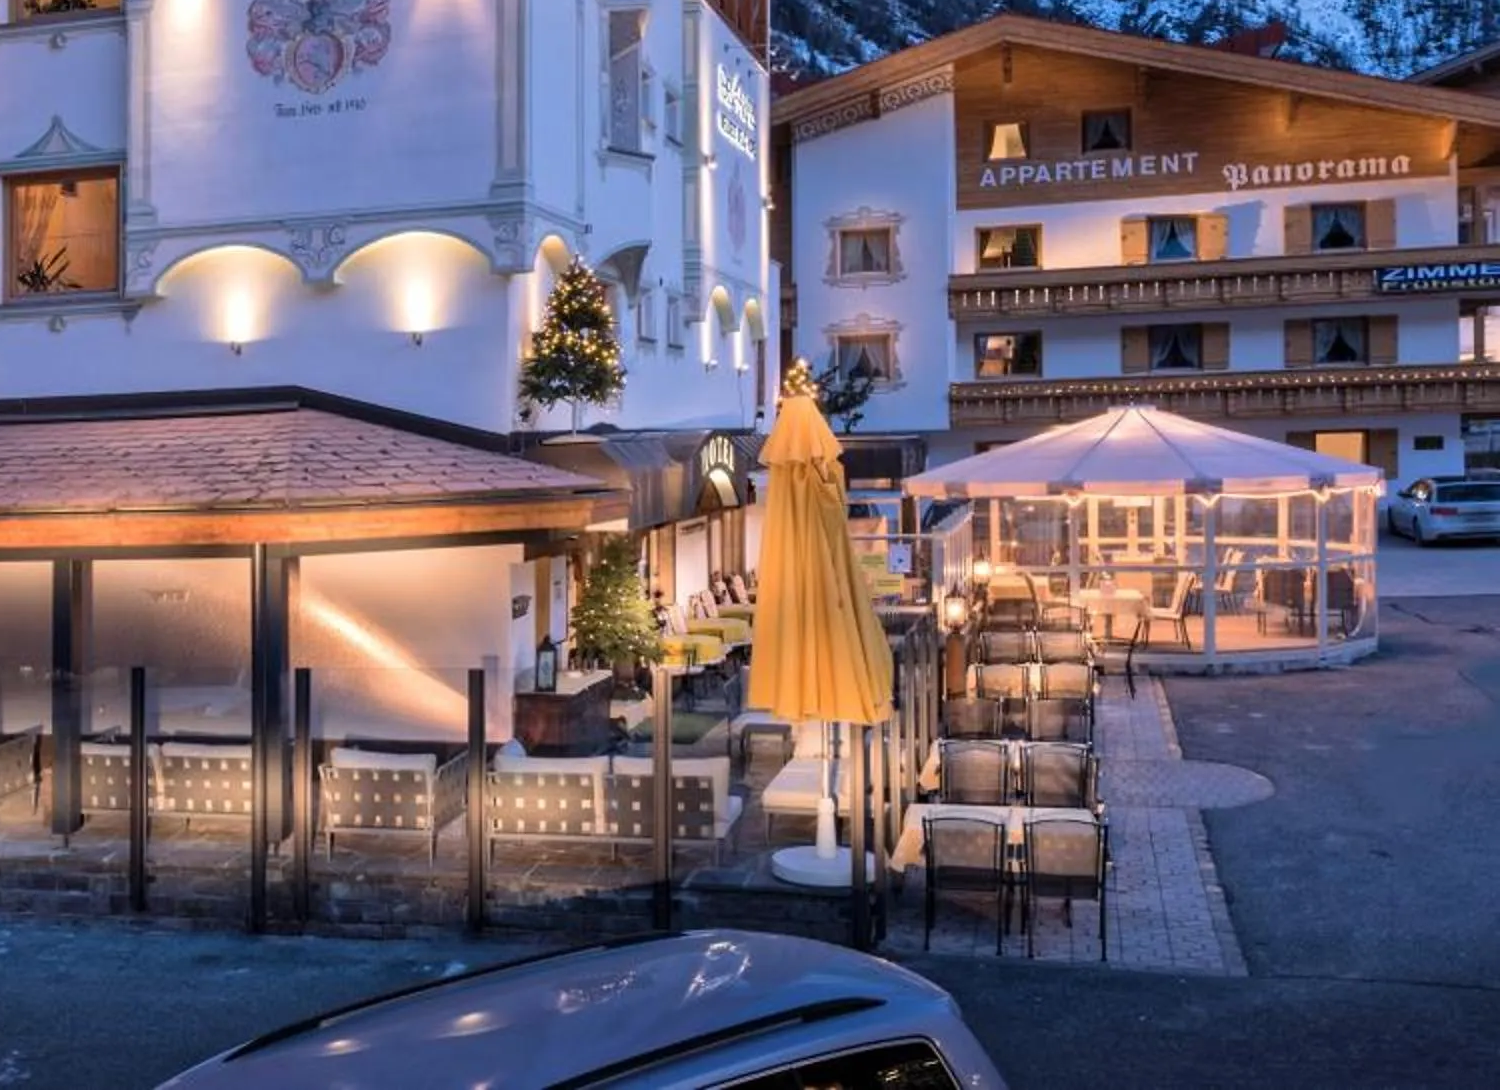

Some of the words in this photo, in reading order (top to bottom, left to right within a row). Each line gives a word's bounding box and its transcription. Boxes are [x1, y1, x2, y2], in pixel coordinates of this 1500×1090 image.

[979, 152, 1199, 188] APPARTEMENT
[1222, 155, 1412, 191] Panorama
[700, 435, 735, 477] HOTEL
